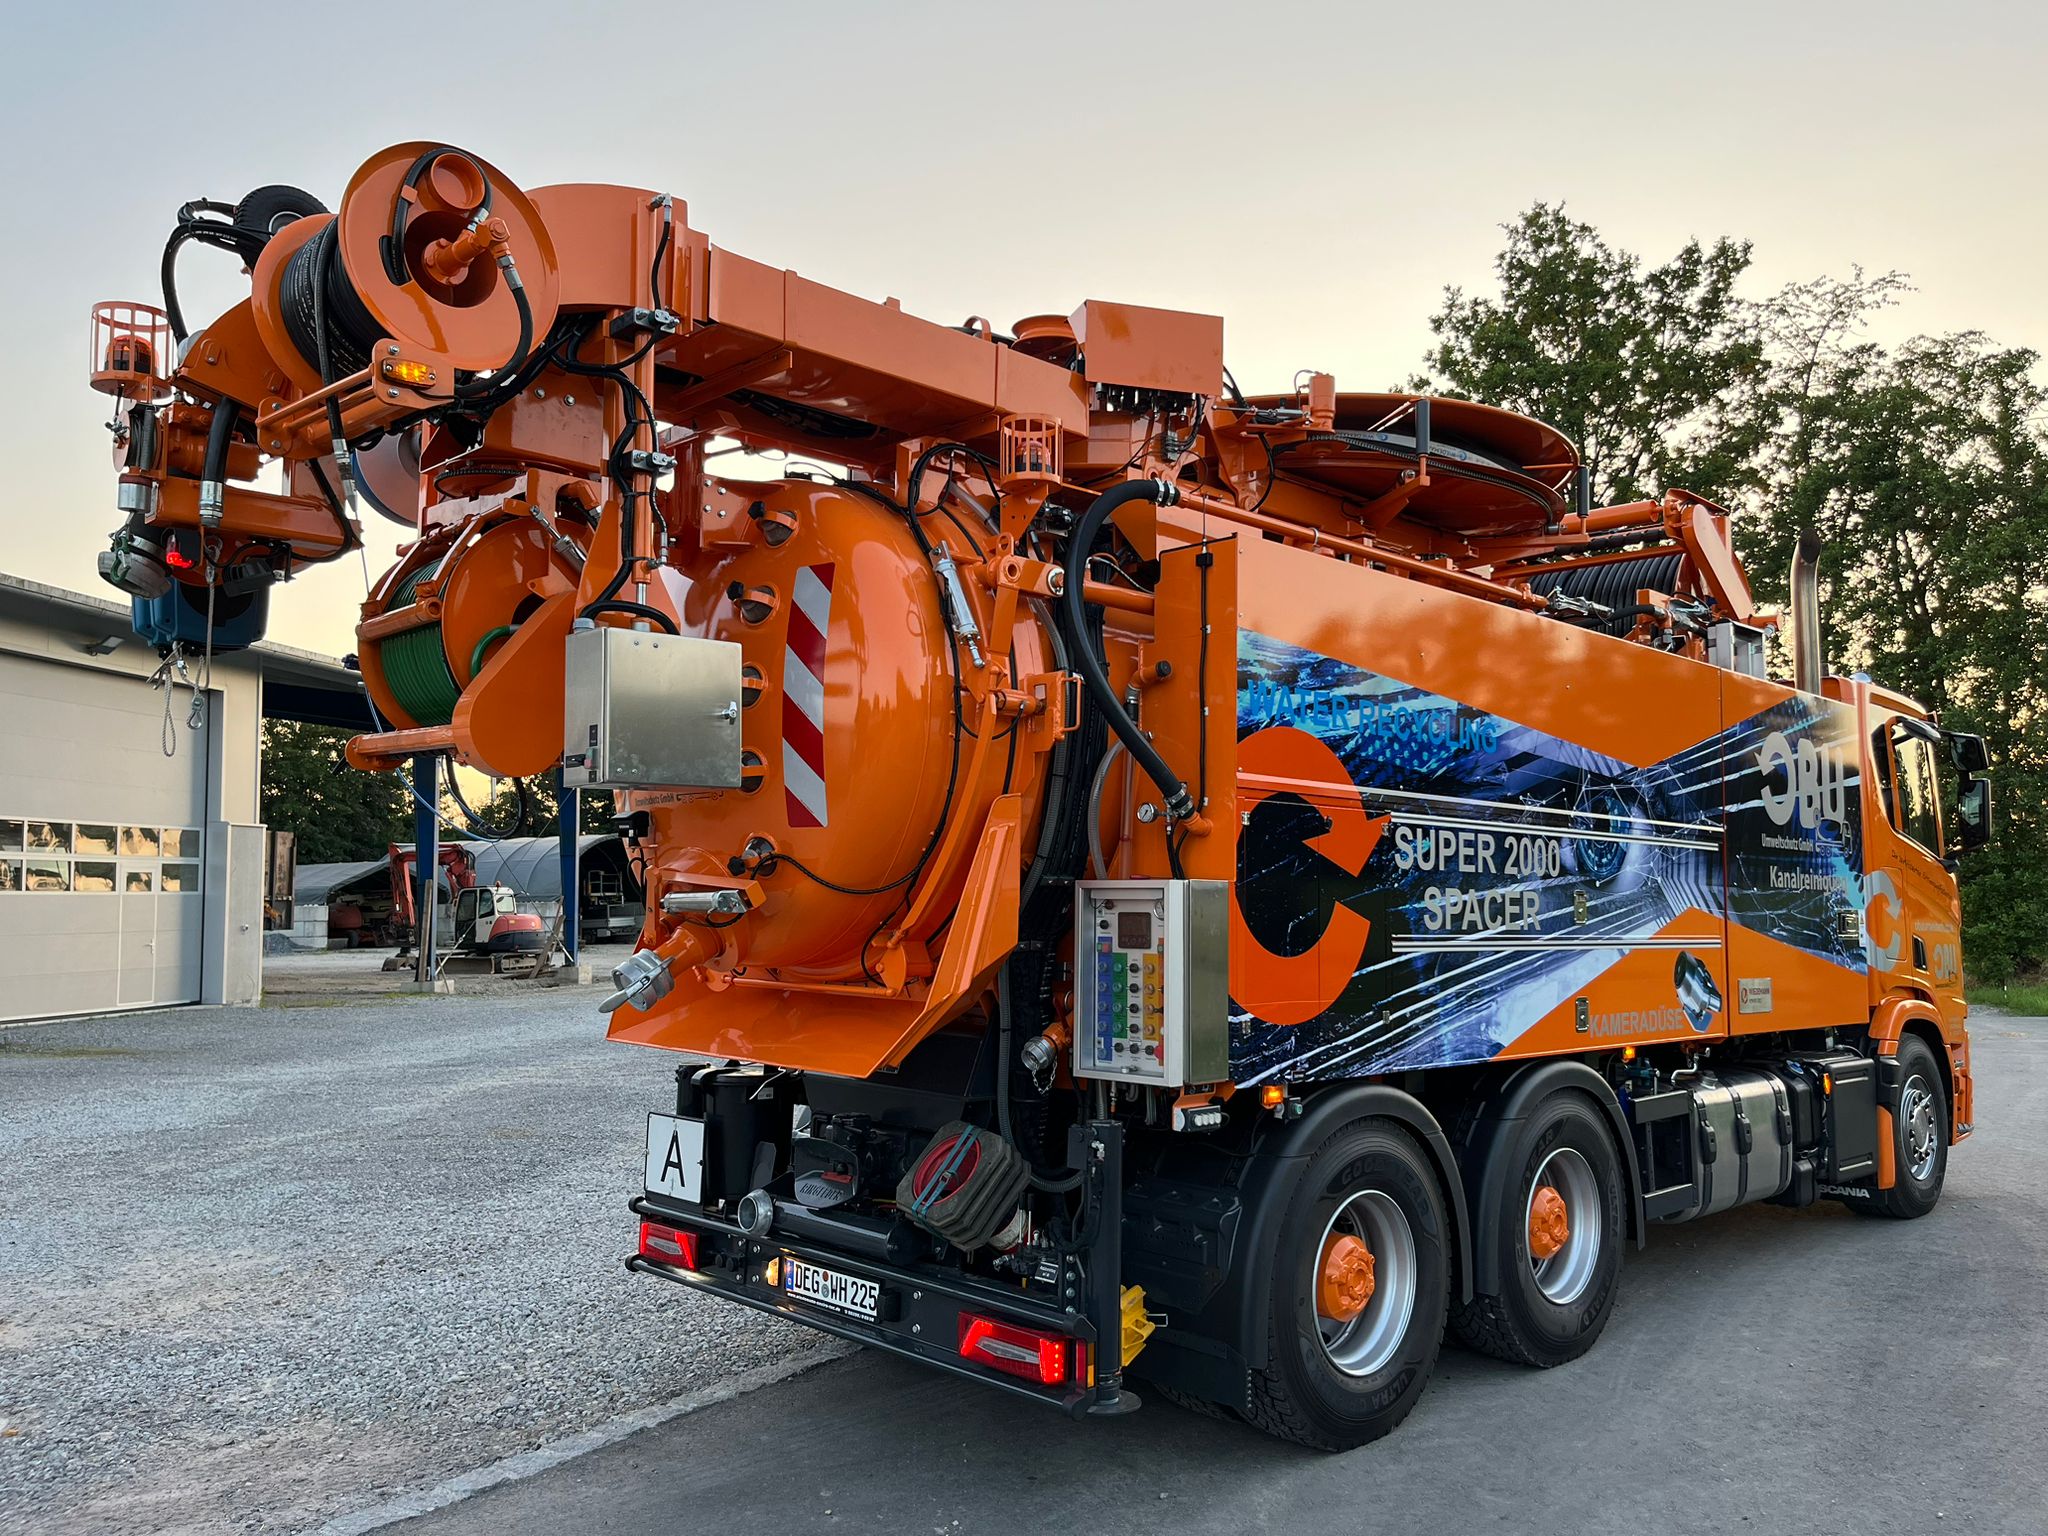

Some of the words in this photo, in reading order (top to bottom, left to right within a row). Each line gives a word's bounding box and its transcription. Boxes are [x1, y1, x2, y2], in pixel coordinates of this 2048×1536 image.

[1248, 679, 1350, 730] WATER
[1359, 699, 1497, 754] RECYCLING
[1394, 826, 1497, 874] SUPER
[1504, 835, 1561, 878] 2000
[1761, 833, 1799, 851] Umweltschutz
[1798, 837, 1814, 852] GmbH
[1423, 886, 1542, 931] SPACER
[1589, 1004, 1685, 1038] KAMERADÜSE
[660, 1129, 686, 1188] A
[1819, 1183, 1871, 1199] SCANIA
[794, 1263, 820, 1295] DEG
[830, 1274, 848, 1304] WH
[850, 1280, 878, 1312] 225
